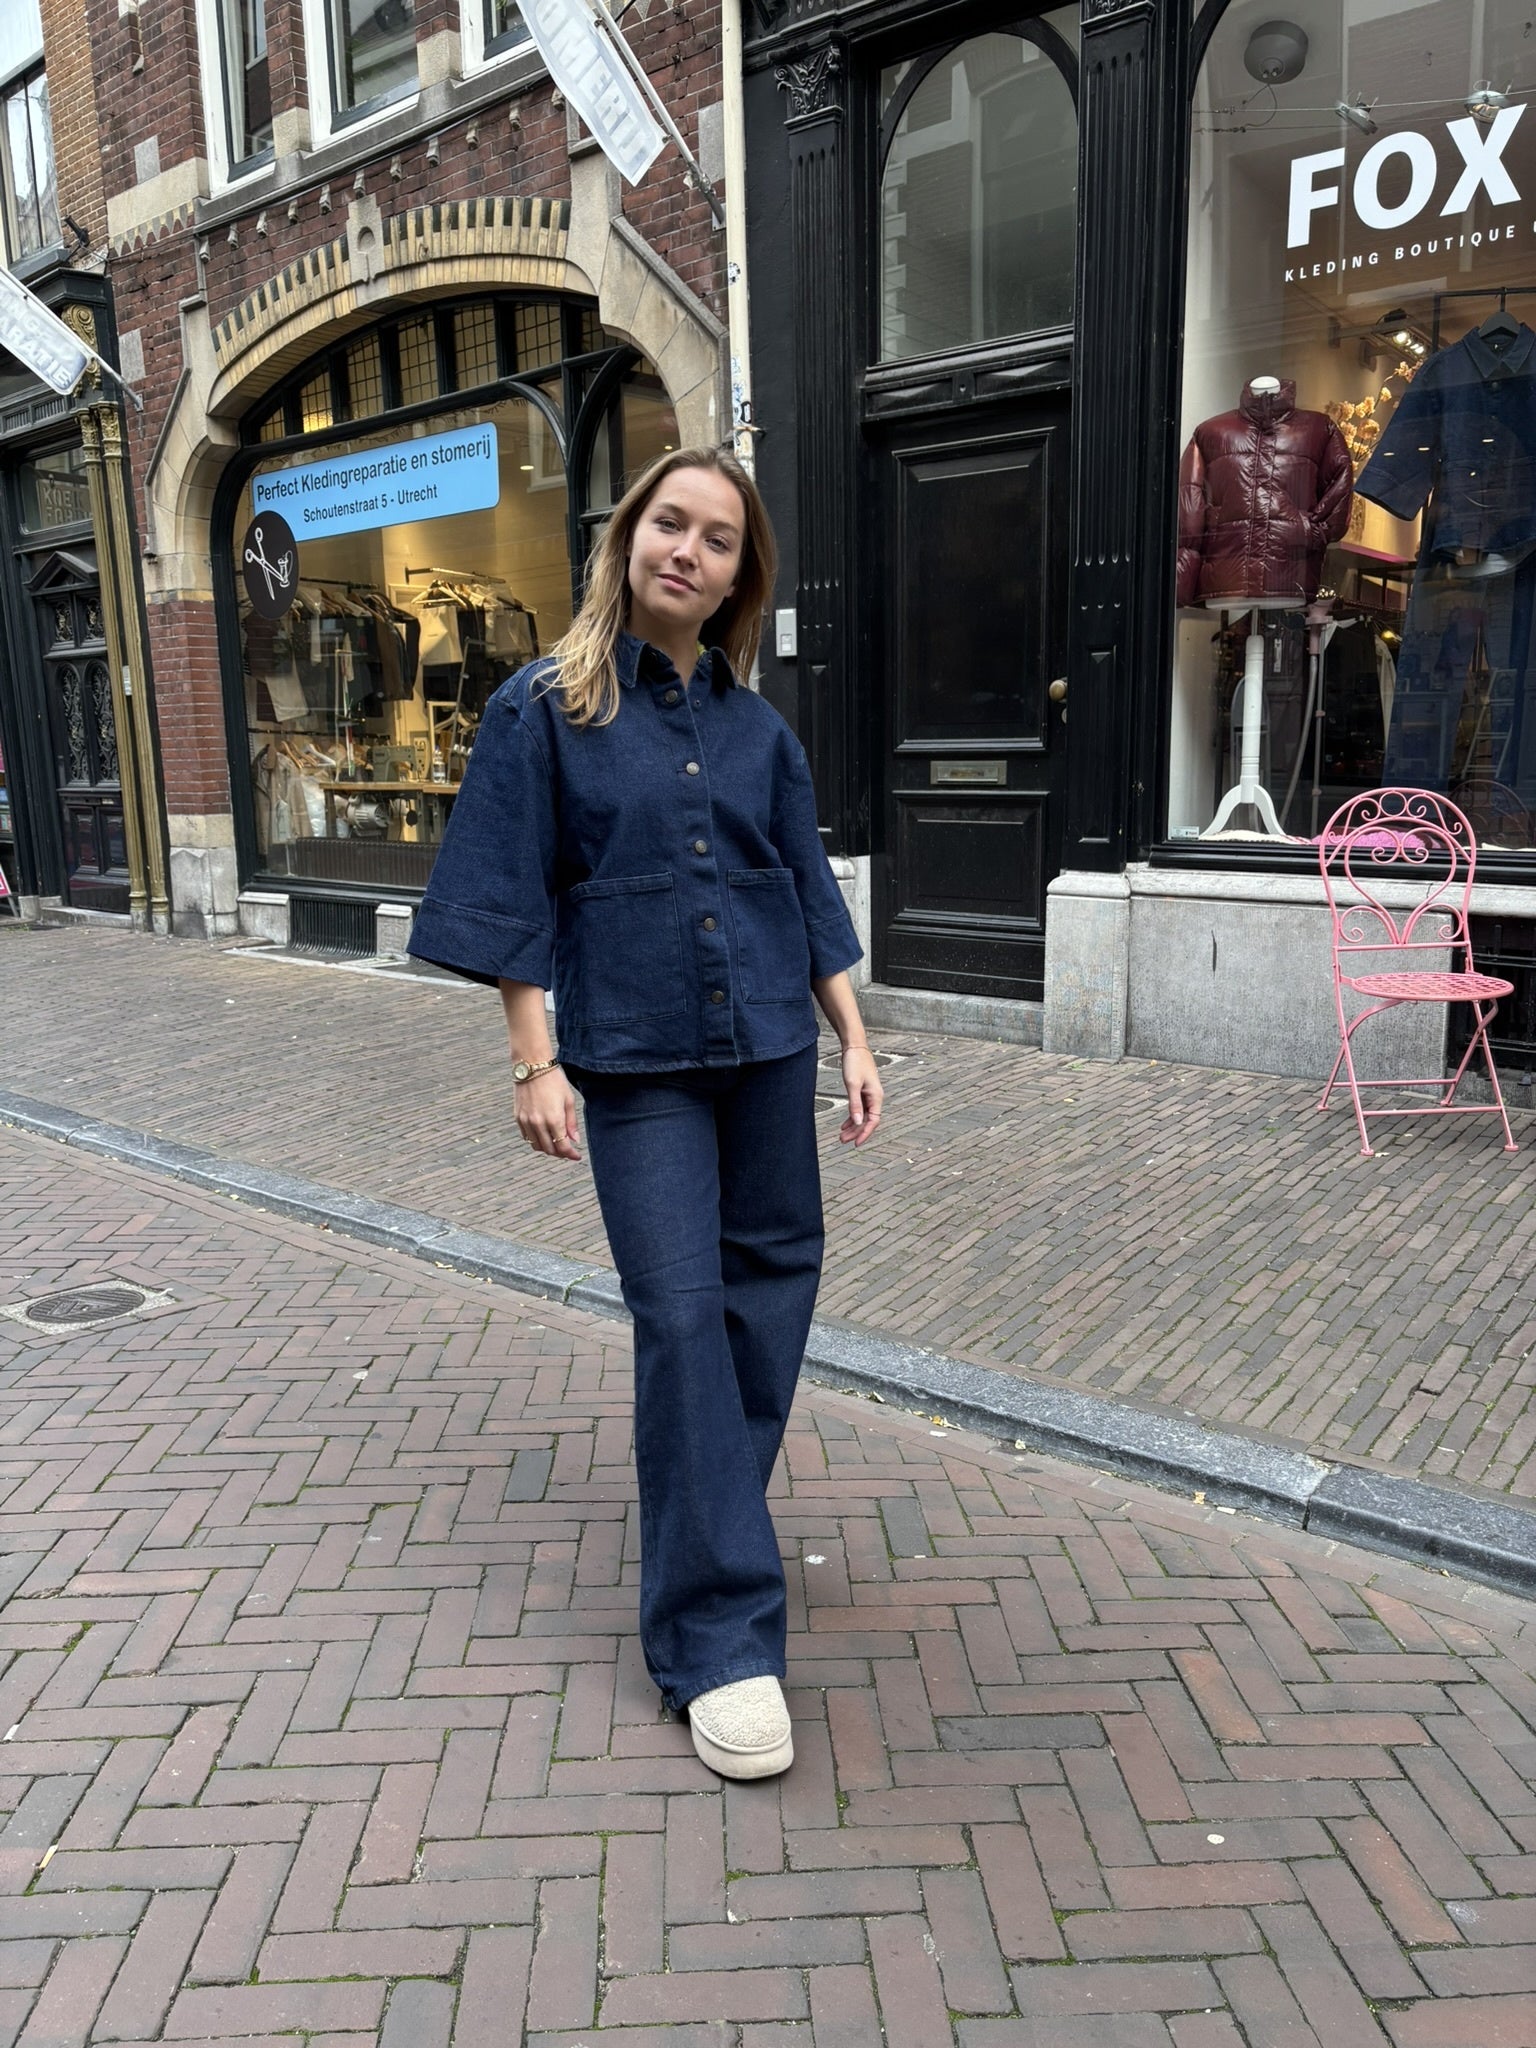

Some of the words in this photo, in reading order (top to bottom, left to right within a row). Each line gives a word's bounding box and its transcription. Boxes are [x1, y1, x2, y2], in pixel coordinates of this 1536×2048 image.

[1287, 103, 1528, 249] FOX
[1285, 252, 1379, 283] KLEDING
[1395, 225, 1516, 260] BOUTIQUE
[257, 477, 299, 502] Perfect
[301, 454, 407, 492] Kledingreparatie
[411, 451, 428, 470] en
[431, 434, 491, 466] stomerij
[303, 496, 379, 523] Schoutenstraat
[381, 493, 388, 509] 5
[398, 484, 438, 505] Utrecht
